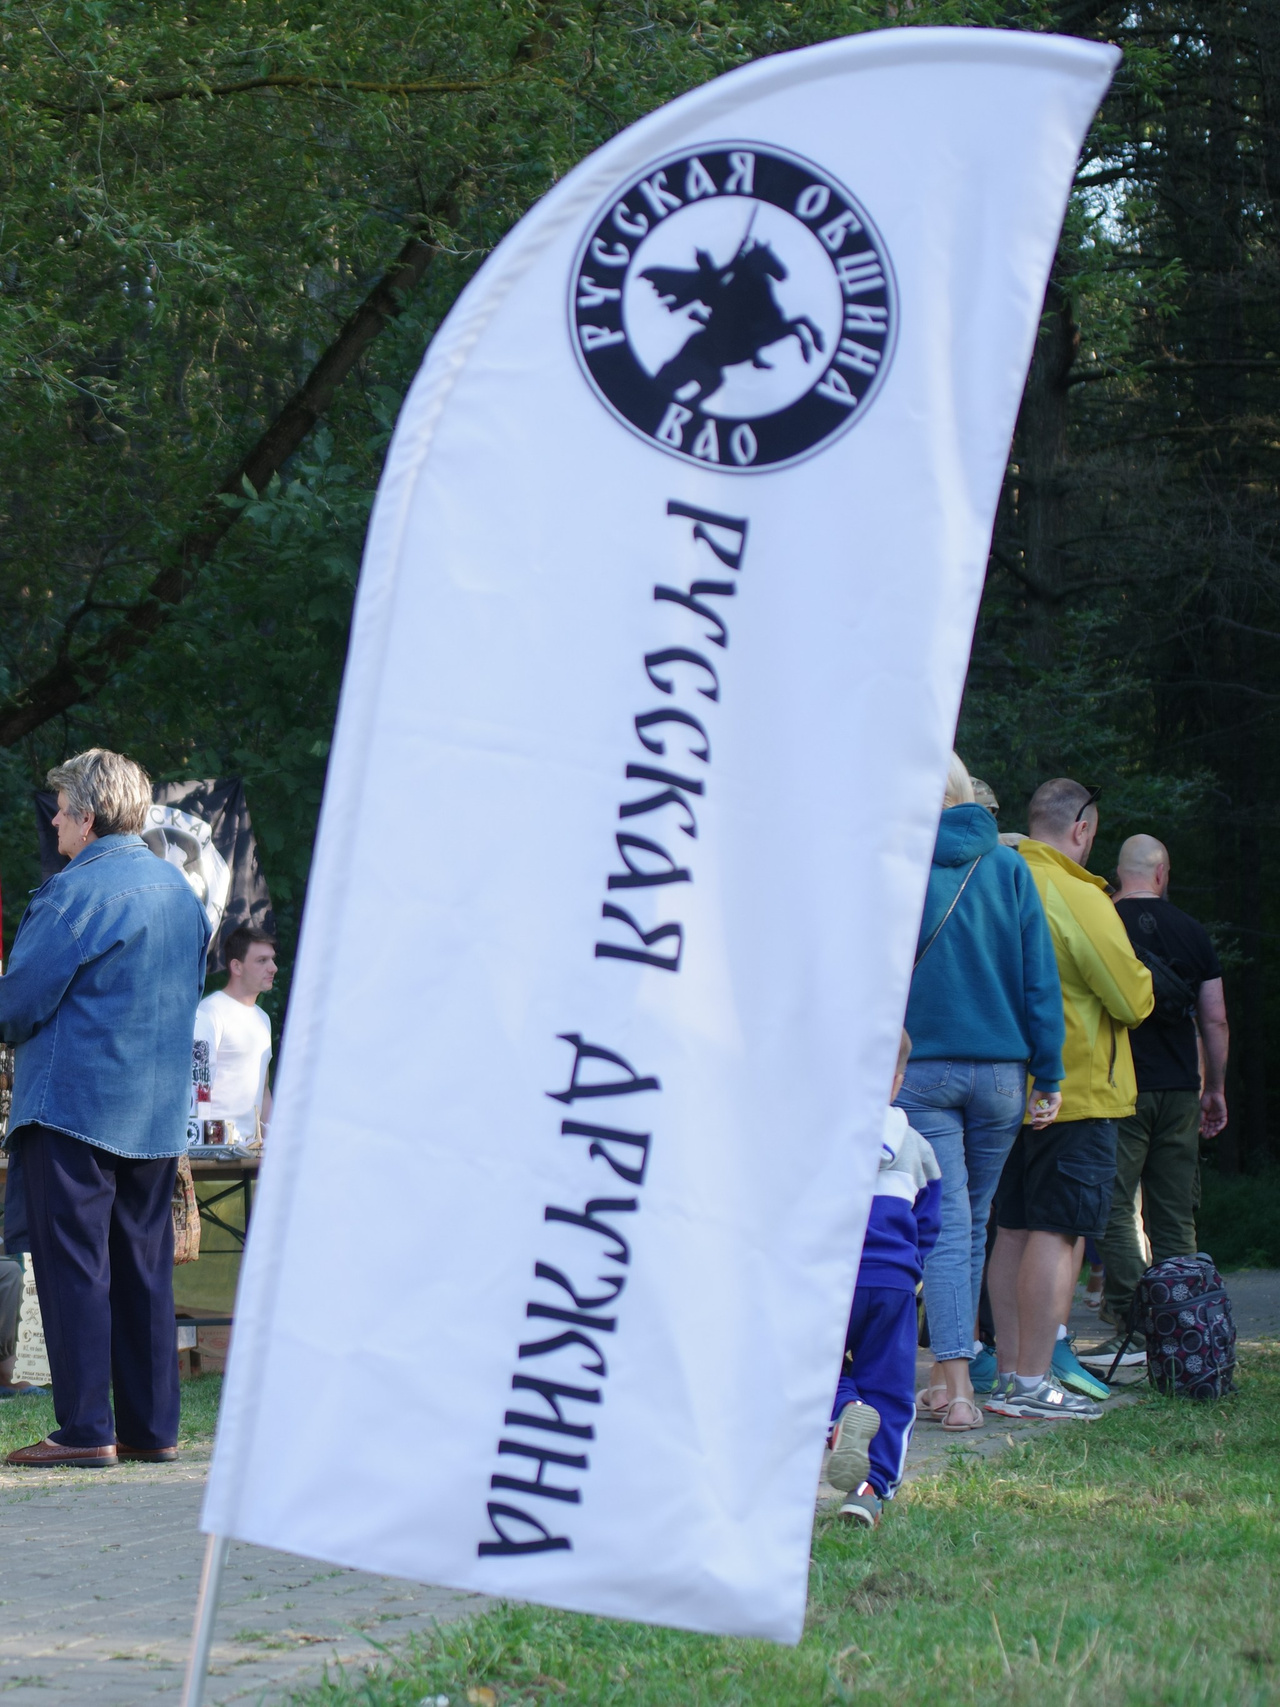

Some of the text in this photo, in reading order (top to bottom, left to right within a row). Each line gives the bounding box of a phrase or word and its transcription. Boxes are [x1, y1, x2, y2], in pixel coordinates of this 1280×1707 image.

[578, 152, 888, 407] РУССКАЯ ОБЩИНА
[655, 402, 758, 466] ВАО
[478, 498, 749, 1558] РУССКАЯ ДРУЖИНА
[1047, 1390, 1064, 1405] N
